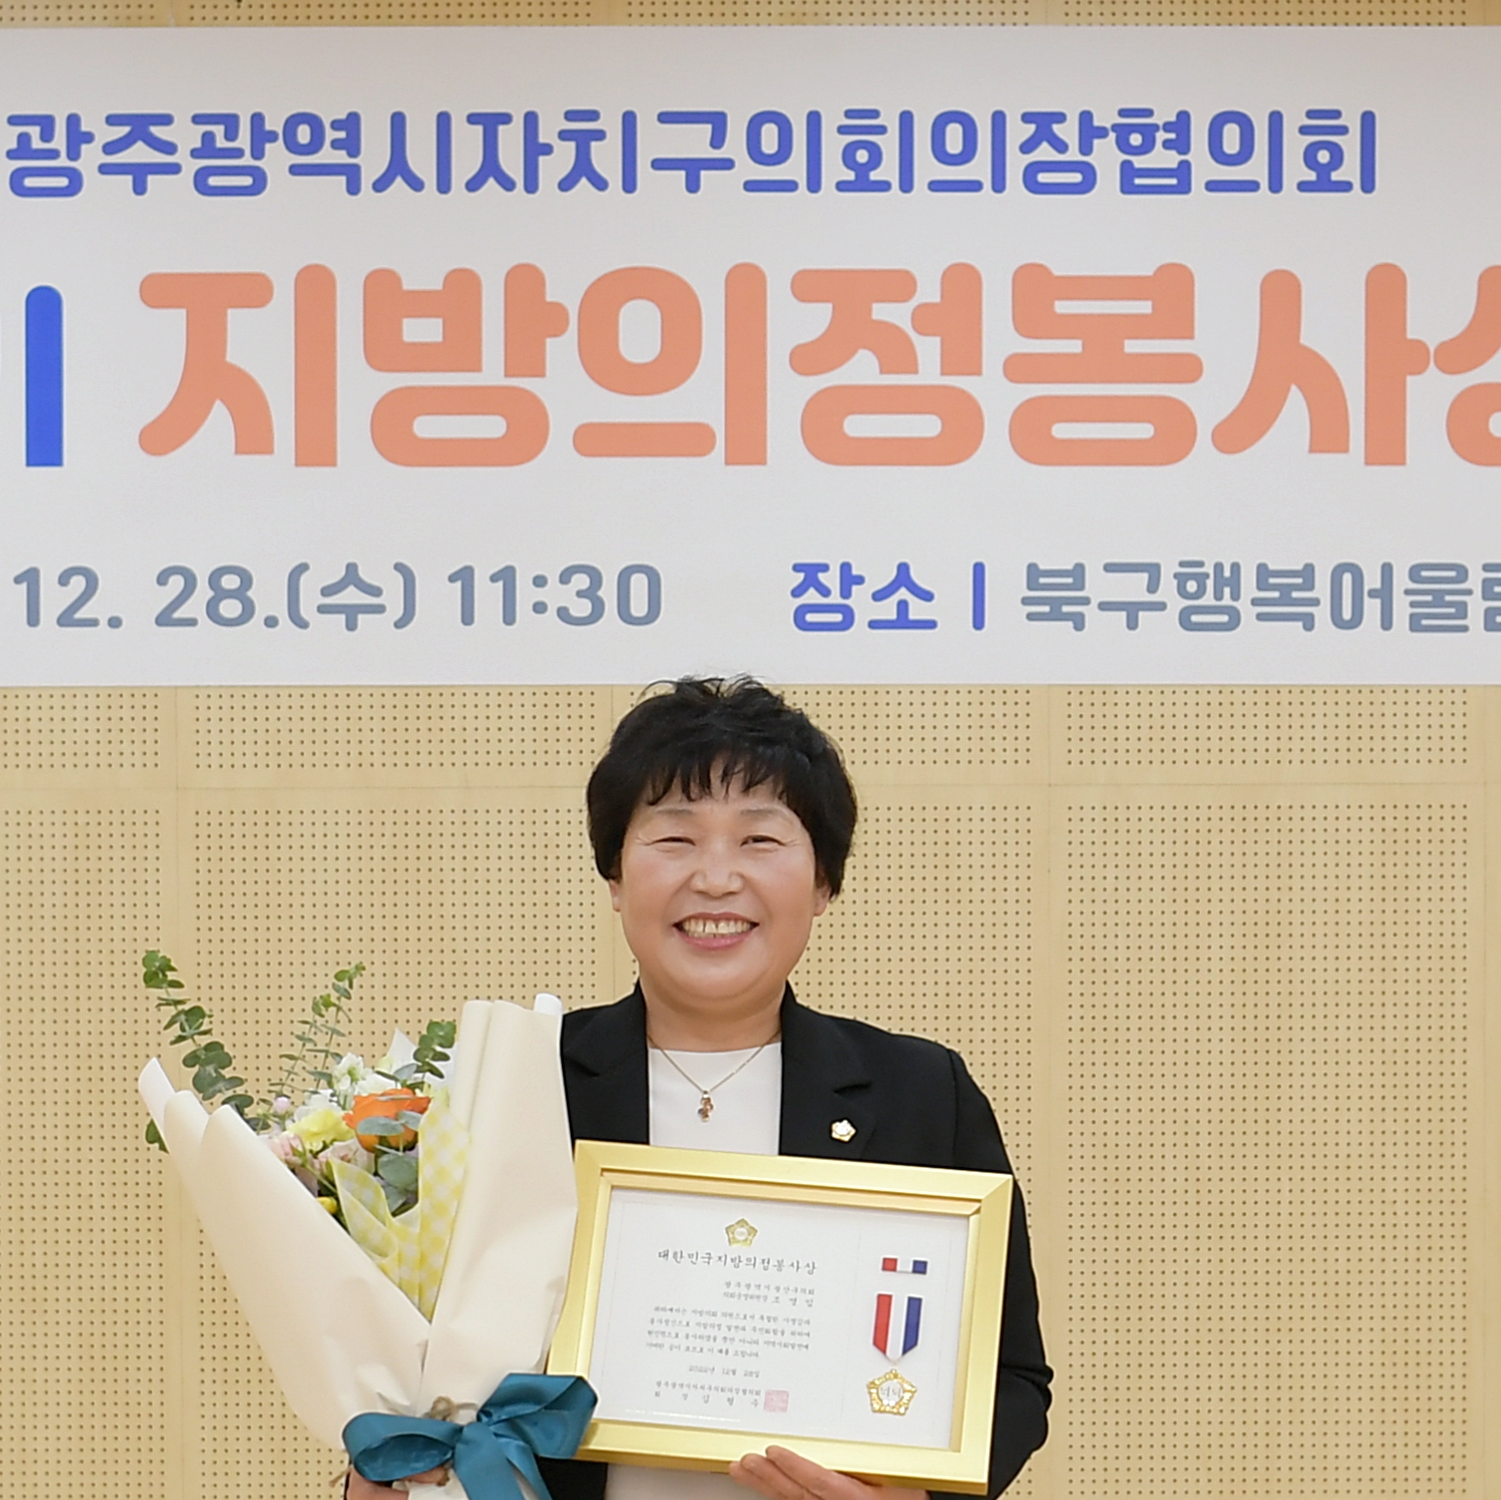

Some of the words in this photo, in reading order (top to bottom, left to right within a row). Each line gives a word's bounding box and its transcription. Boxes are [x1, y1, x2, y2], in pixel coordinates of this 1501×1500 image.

[4, 106, 1378, 199] 광주광역시자치구의회의장협의회
[12, 566, 124, 628] 12.
[154, 562, 417, 633] 28.(수)
[447, 564, 663, 627] 11:30
[789, 560, 939, 634] 장소
